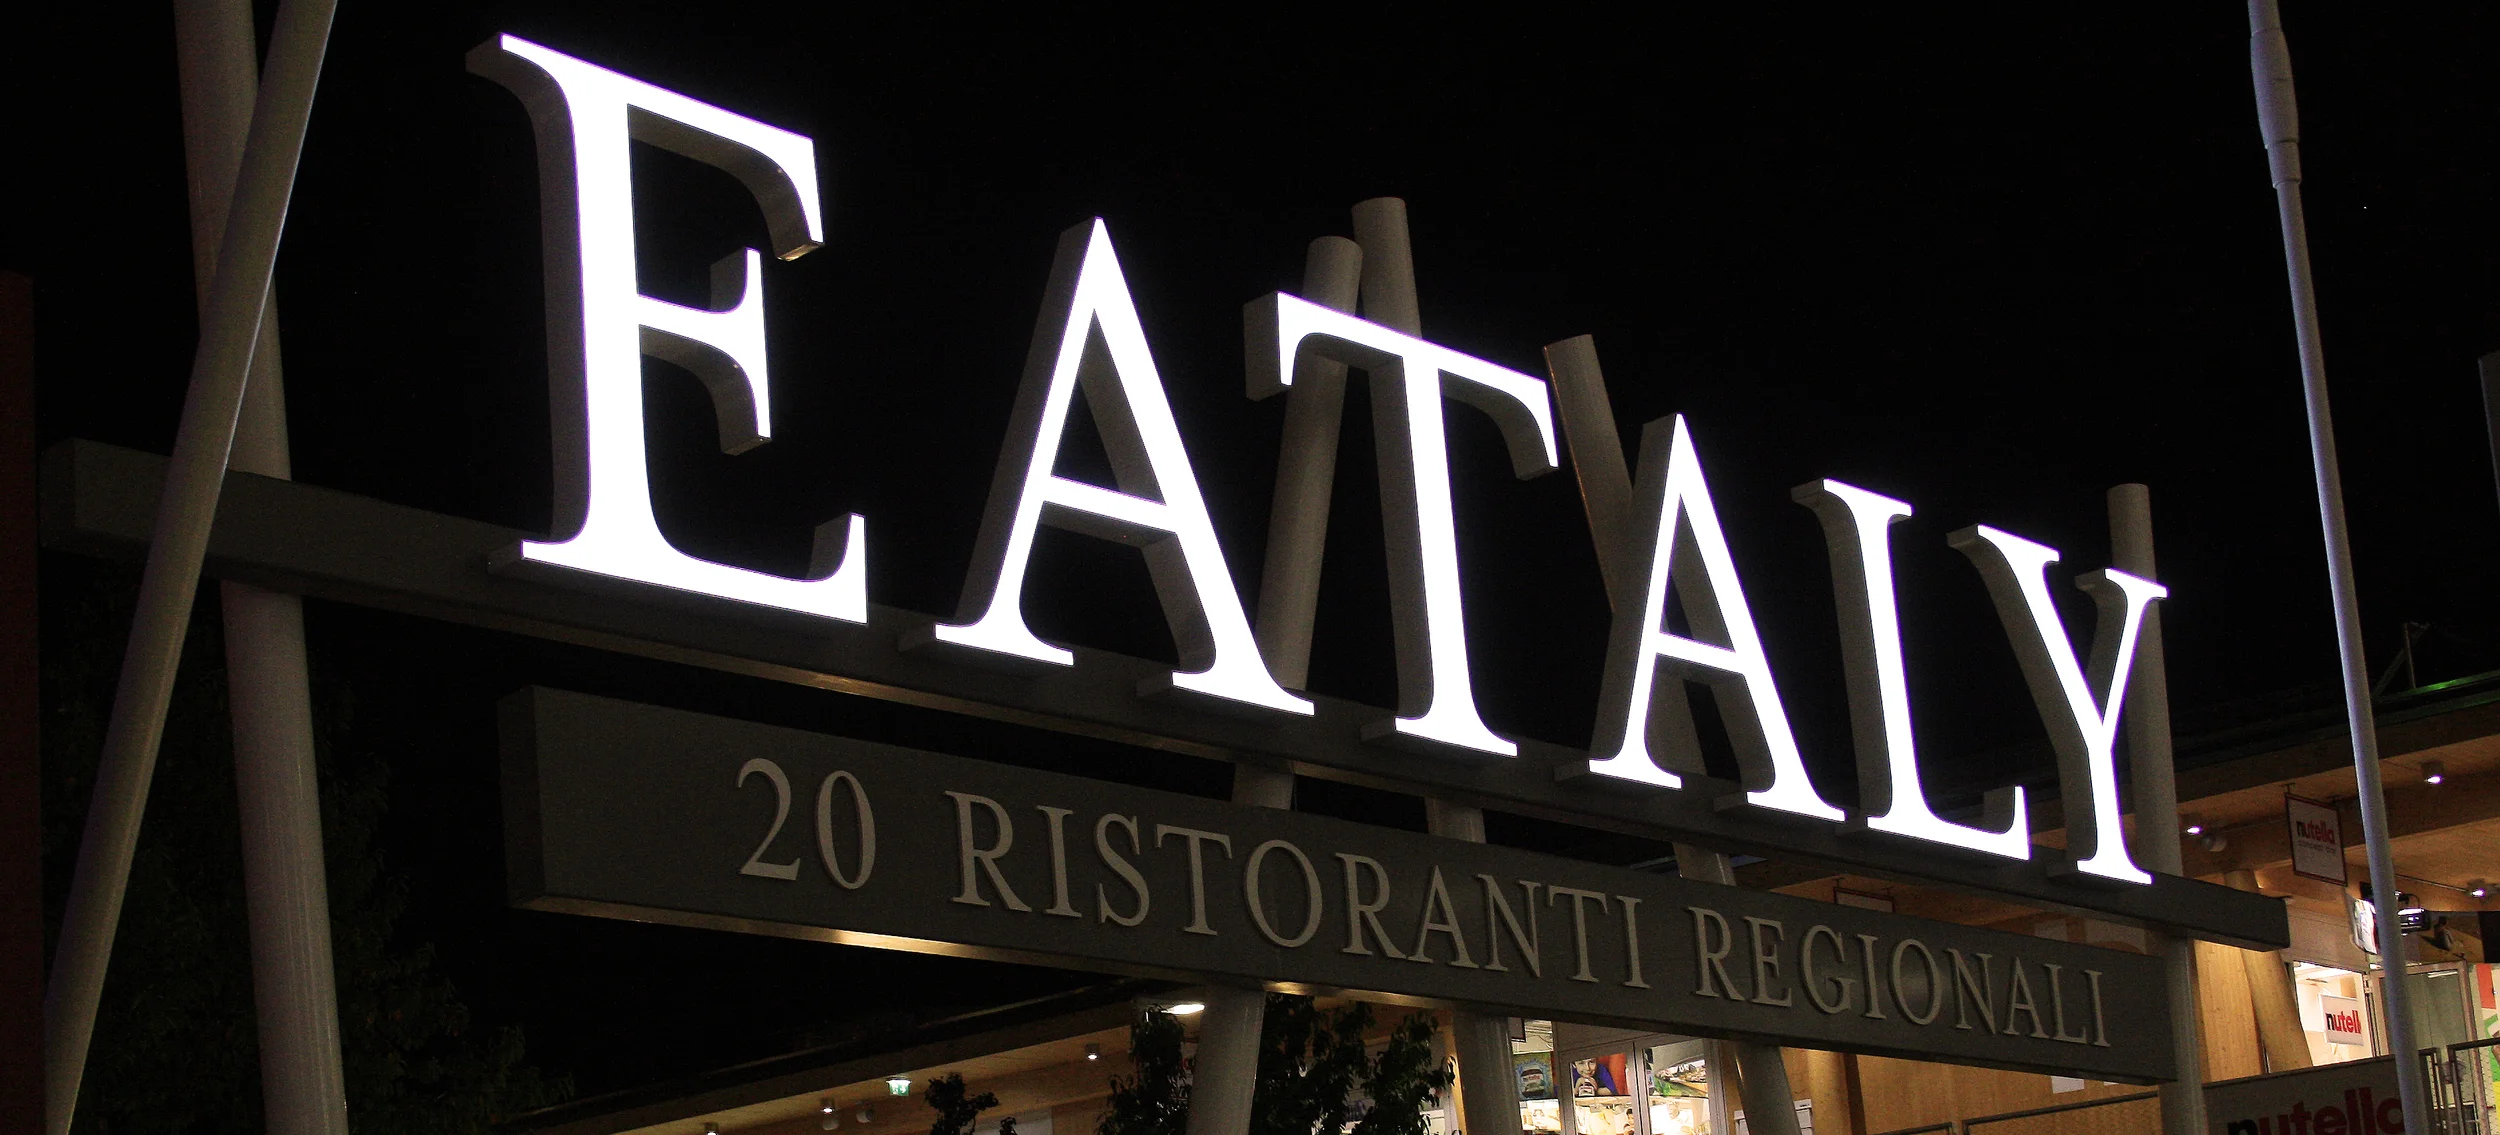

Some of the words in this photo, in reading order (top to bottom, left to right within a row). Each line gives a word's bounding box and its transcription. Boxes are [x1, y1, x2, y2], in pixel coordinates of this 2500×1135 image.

[498, 32, 2170, 885] EATALY
[737, 757, 877, 891] 20
[943, 789, 1652, 990] RISTORANTI
[1686, 905, 2112, 1049] REGIONALI
[2296, 820, 2336, 845] nutella
[2325, 1010, 2362, 1035] nutell
